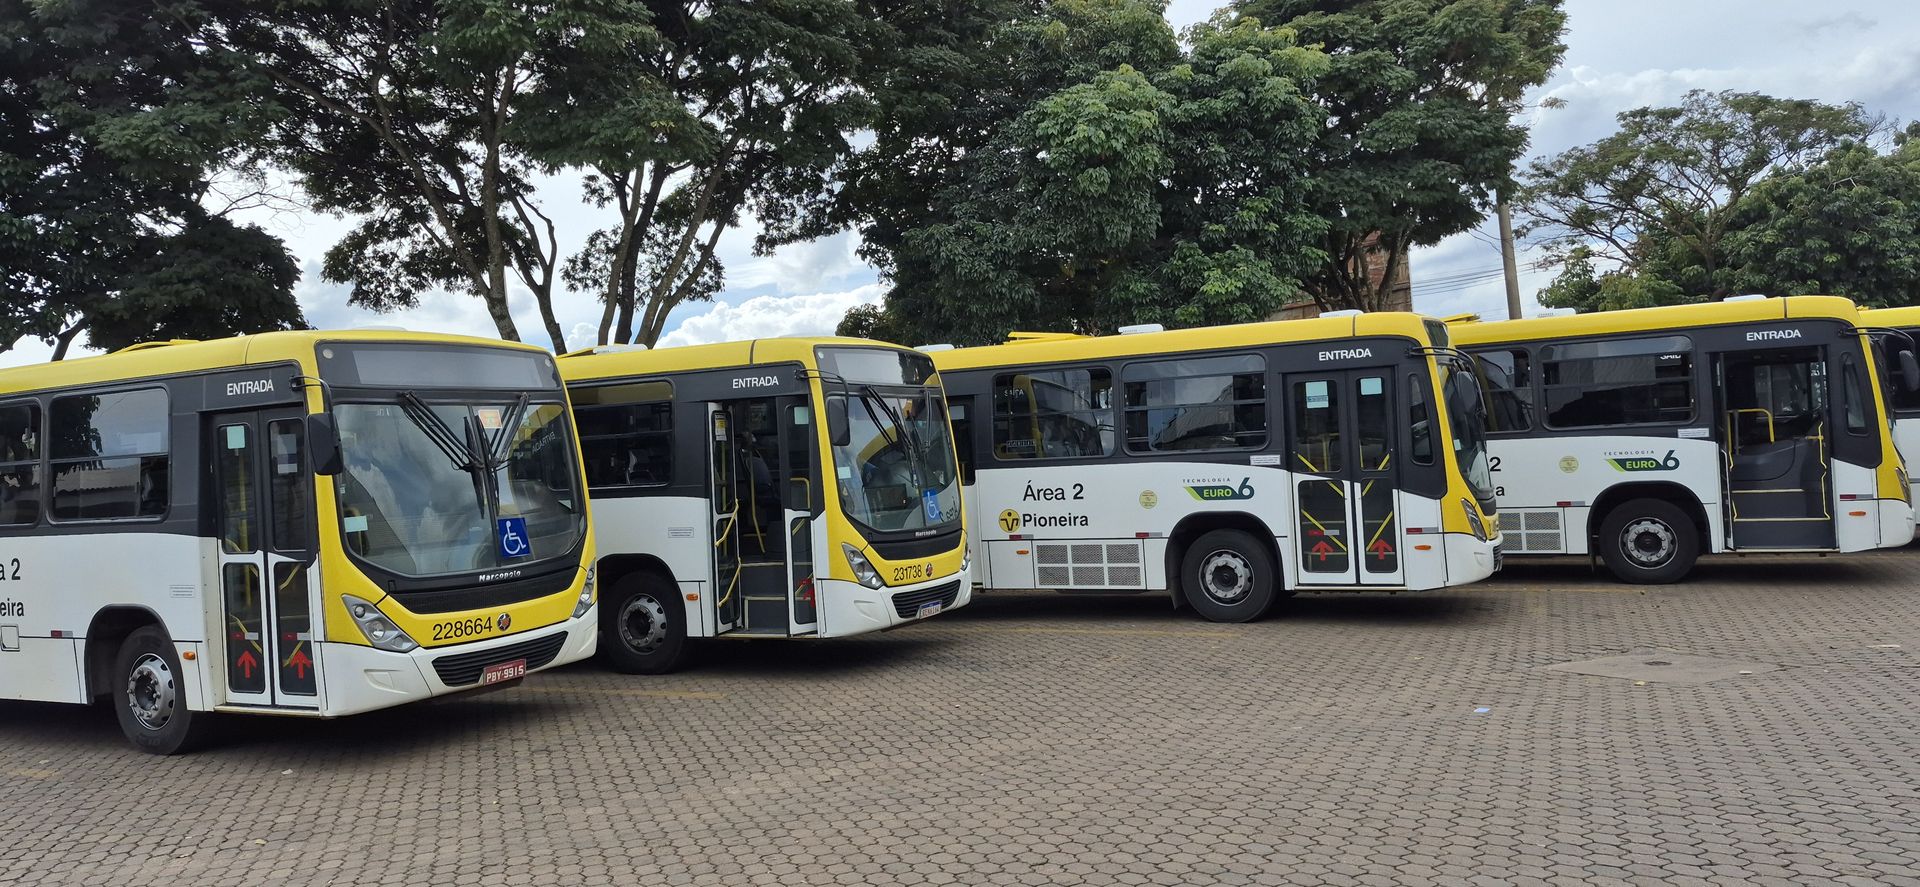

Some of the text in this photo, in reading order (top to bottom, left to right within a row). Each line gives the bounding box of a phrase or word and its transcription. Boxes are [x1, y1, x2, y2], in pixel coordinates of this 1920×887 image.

[1746, 329, 1801, 341] ENTRADA
[1318, 348, 1372, 361] ENTRADA
[226, 379, 274, 395] ENTRADA
[732, 375, 779, 389] ENTRADA
[1489, 456, 1502, 472] 2
[1626, 449, 1680, 471] EURO 6
[1023, 480, 1084, 501] Área 2
[1203, 477, 1255, 500] EURO 6
[1022, 512, 1089, 527] Pioneira
[11, 558, 21, 580] 2
[479, 570, 521, 582] Marcopolo
[893, 565, 922, 581] 231738
[0, 597, 25, 617] eira
[432, 616, 493, 641] 228664
